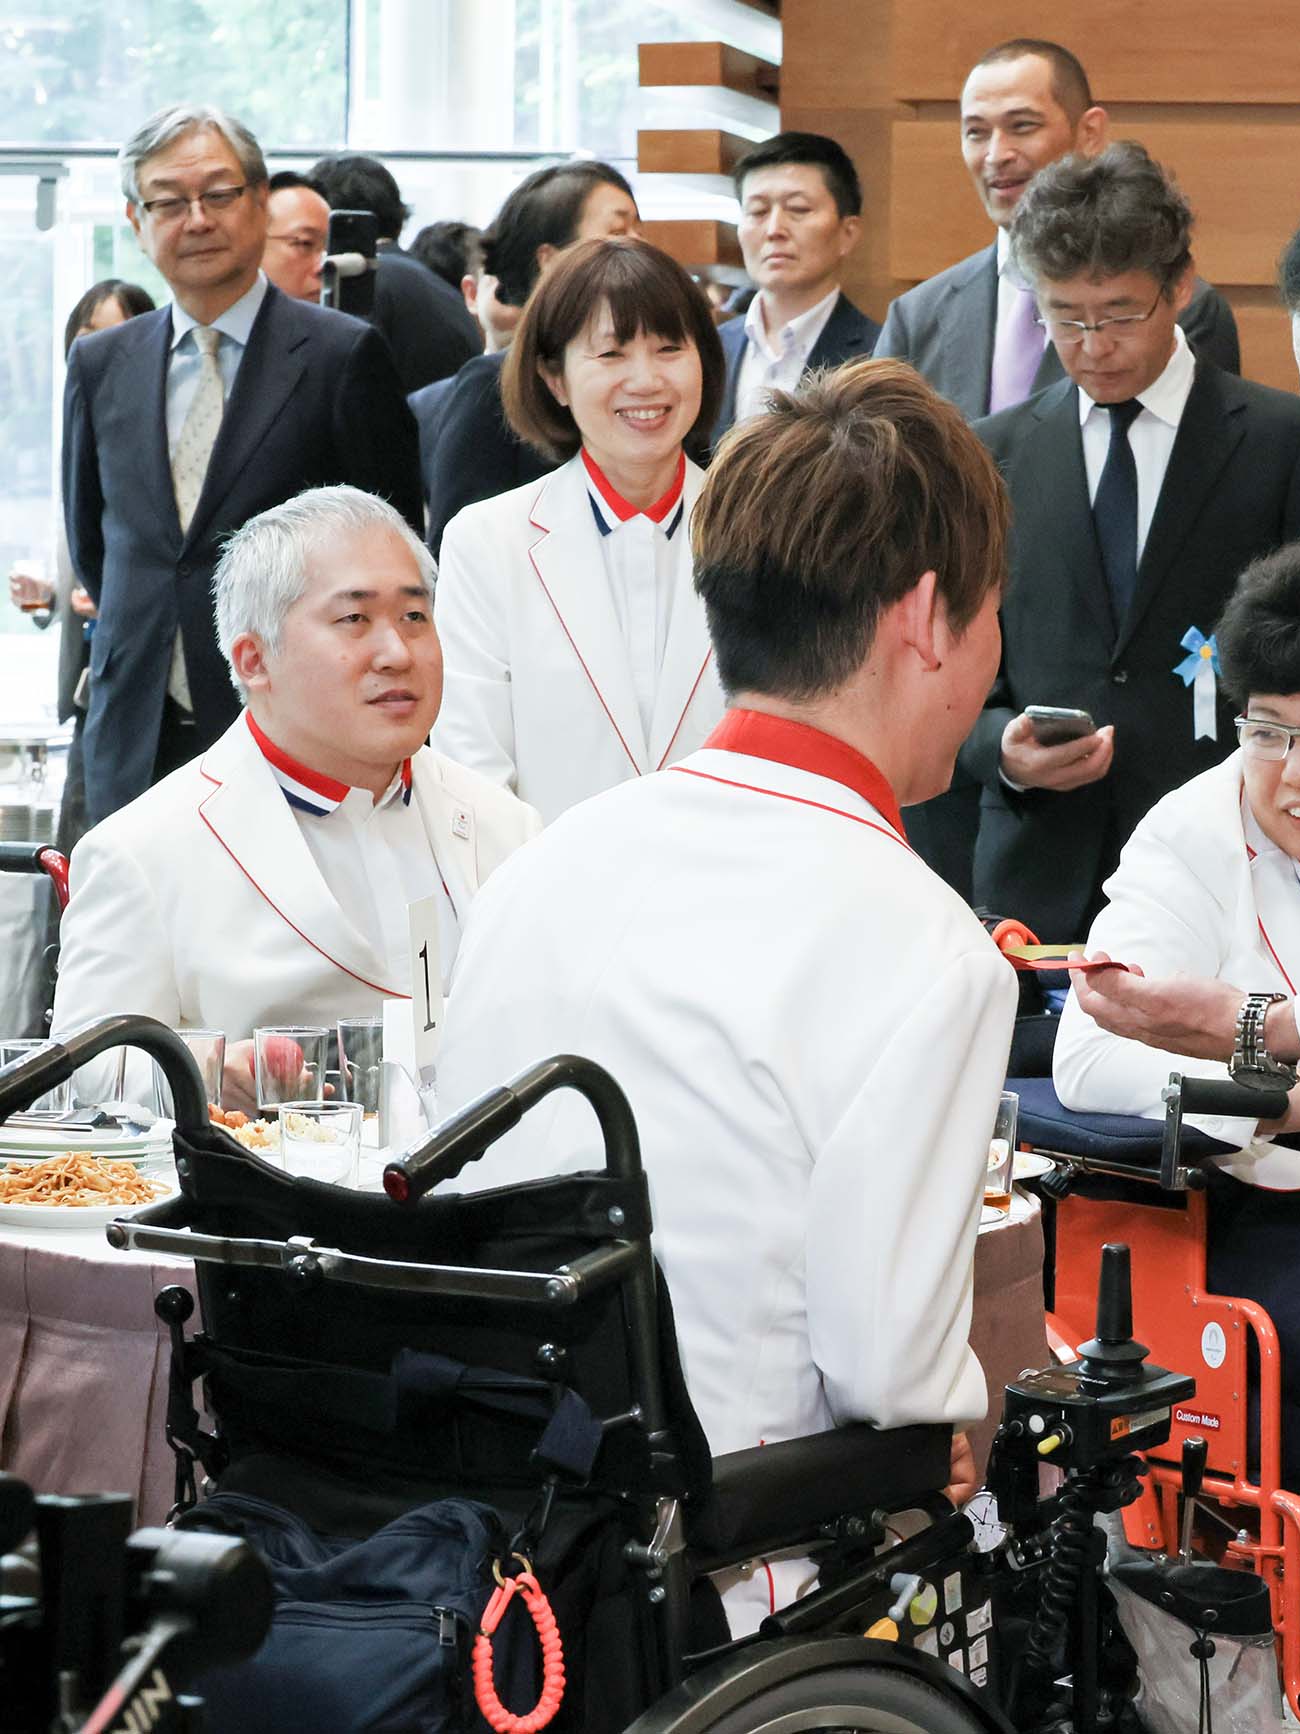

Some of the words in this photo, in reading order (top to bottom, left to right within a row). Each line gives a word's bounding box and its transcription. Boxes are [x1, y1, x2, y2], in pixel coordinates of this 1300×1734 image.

[418, 940, 436, 1032] 1
[1176, 1409, 1200, 1424] Custom
[1201, 1414, 1220, 1428] Made
